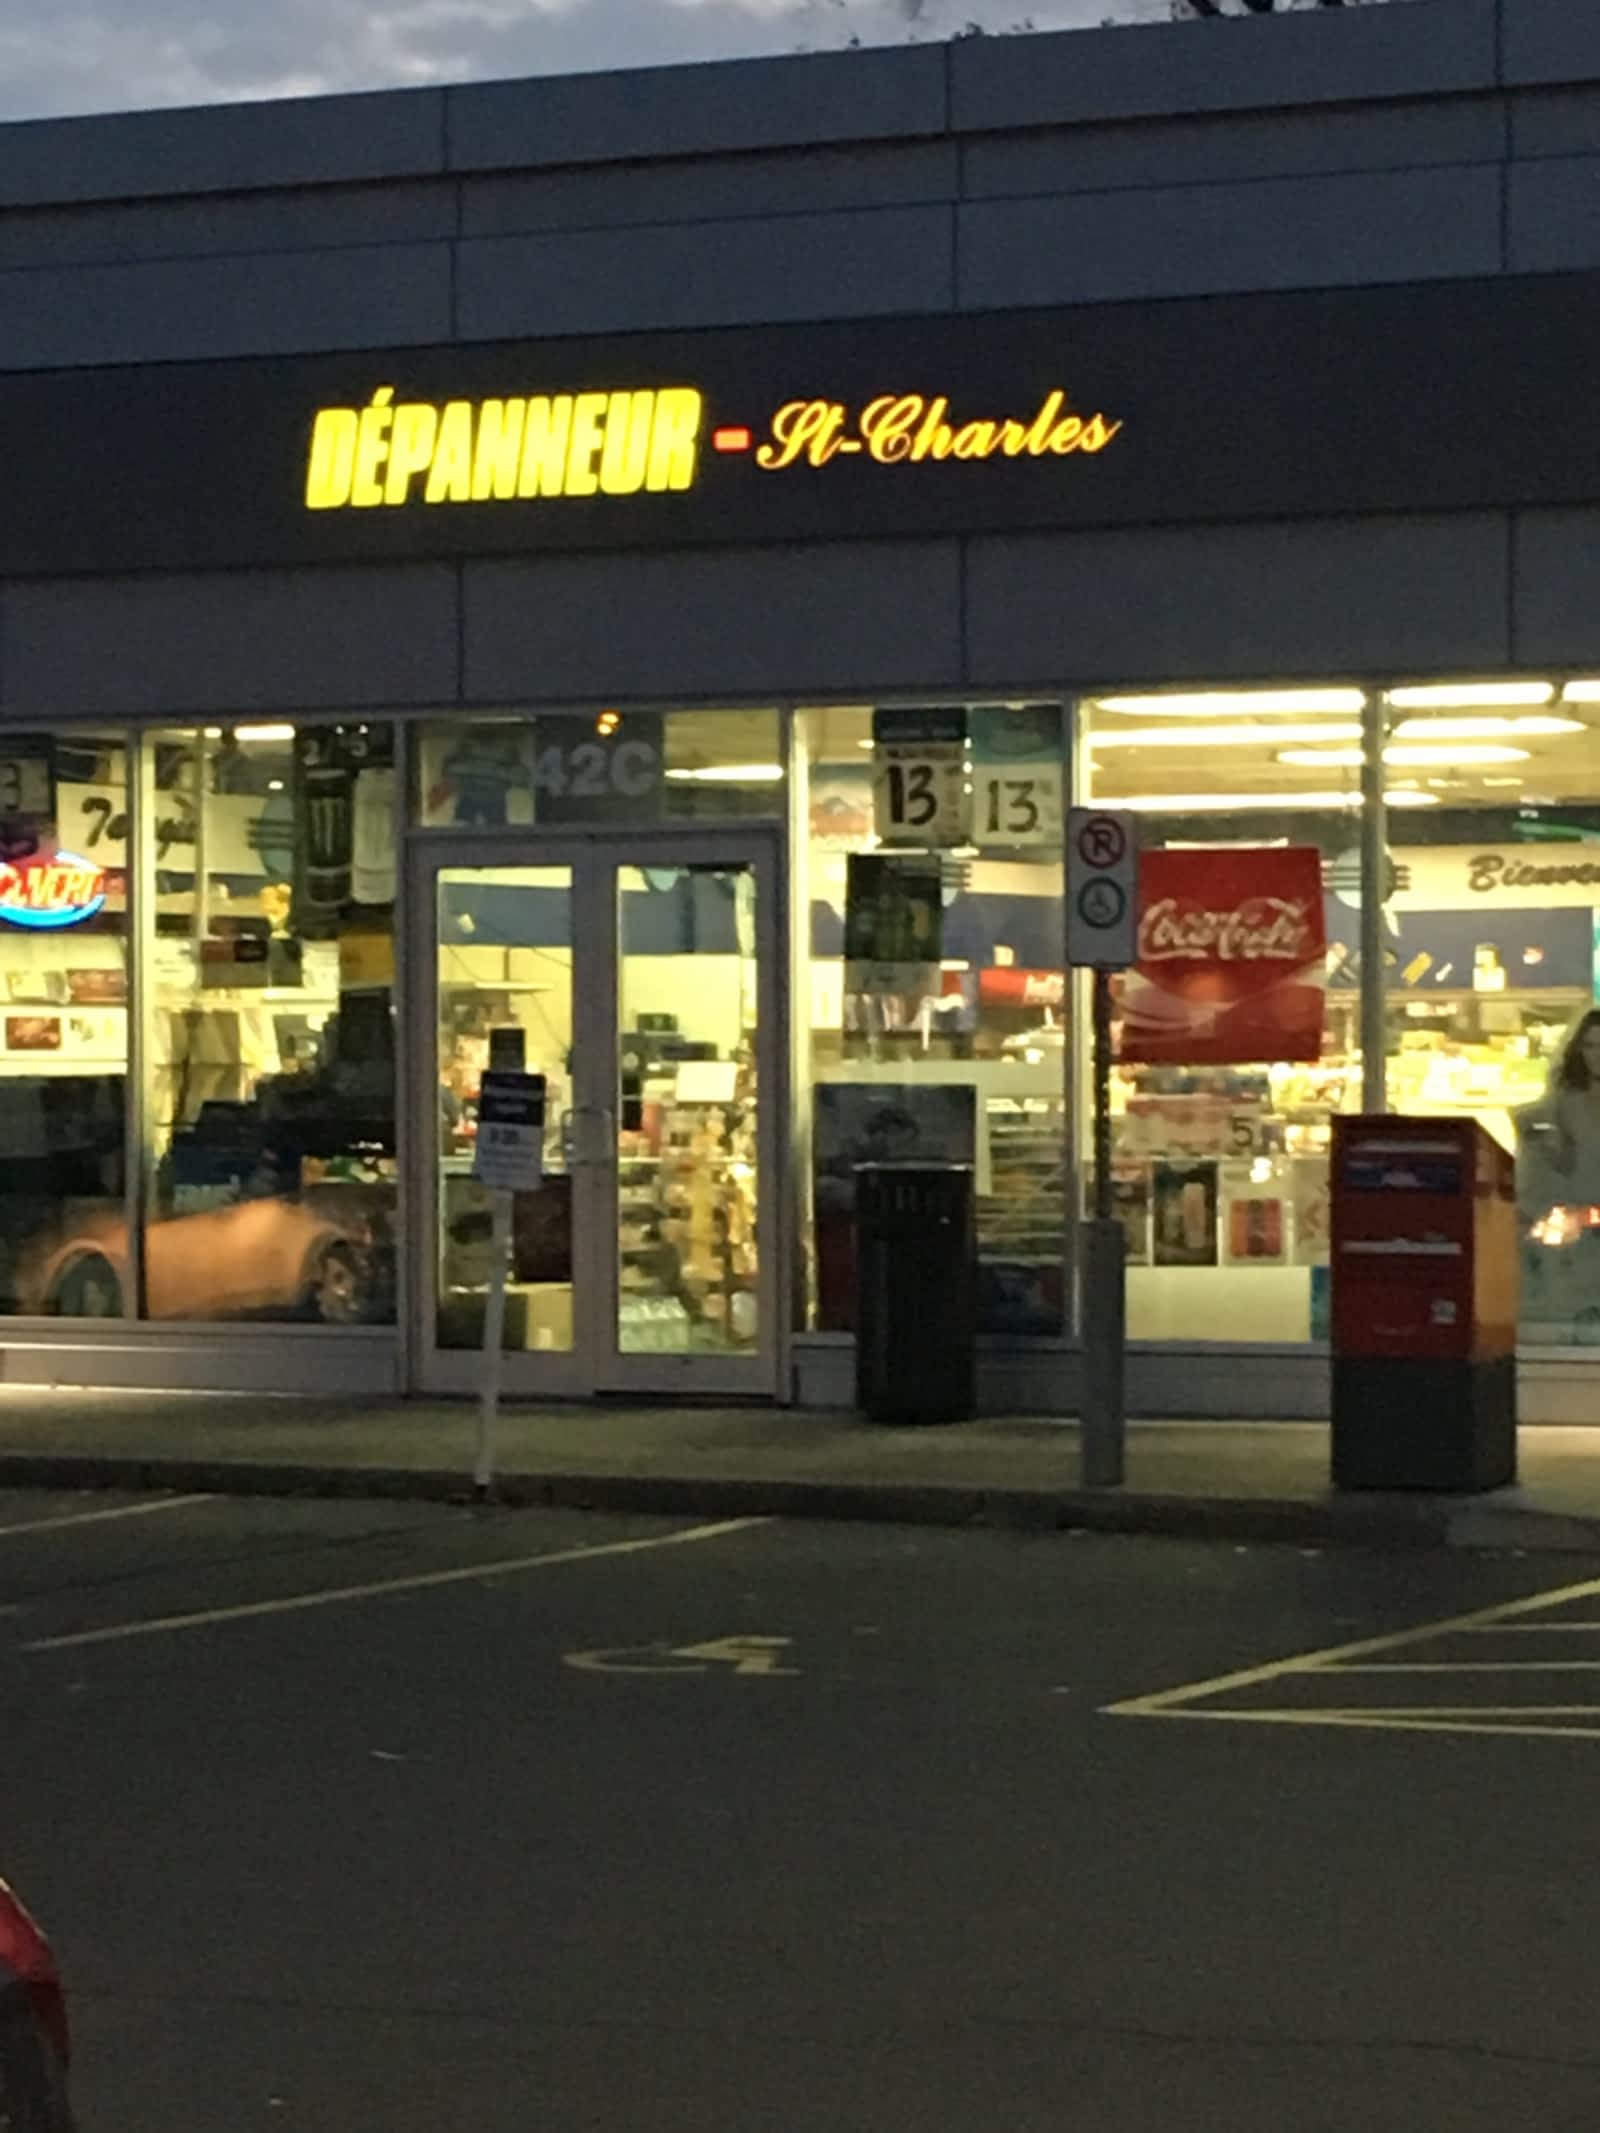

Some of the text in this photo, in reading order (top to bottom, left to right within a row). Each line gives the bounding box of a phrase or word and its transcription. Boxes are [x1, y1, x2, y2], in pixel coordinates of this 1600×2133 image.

[306, 386, 700, 510] DÉPANNEUR
[756, 390, 1122, 470] St-Charles
[533, 741, 656, 797] 42C
